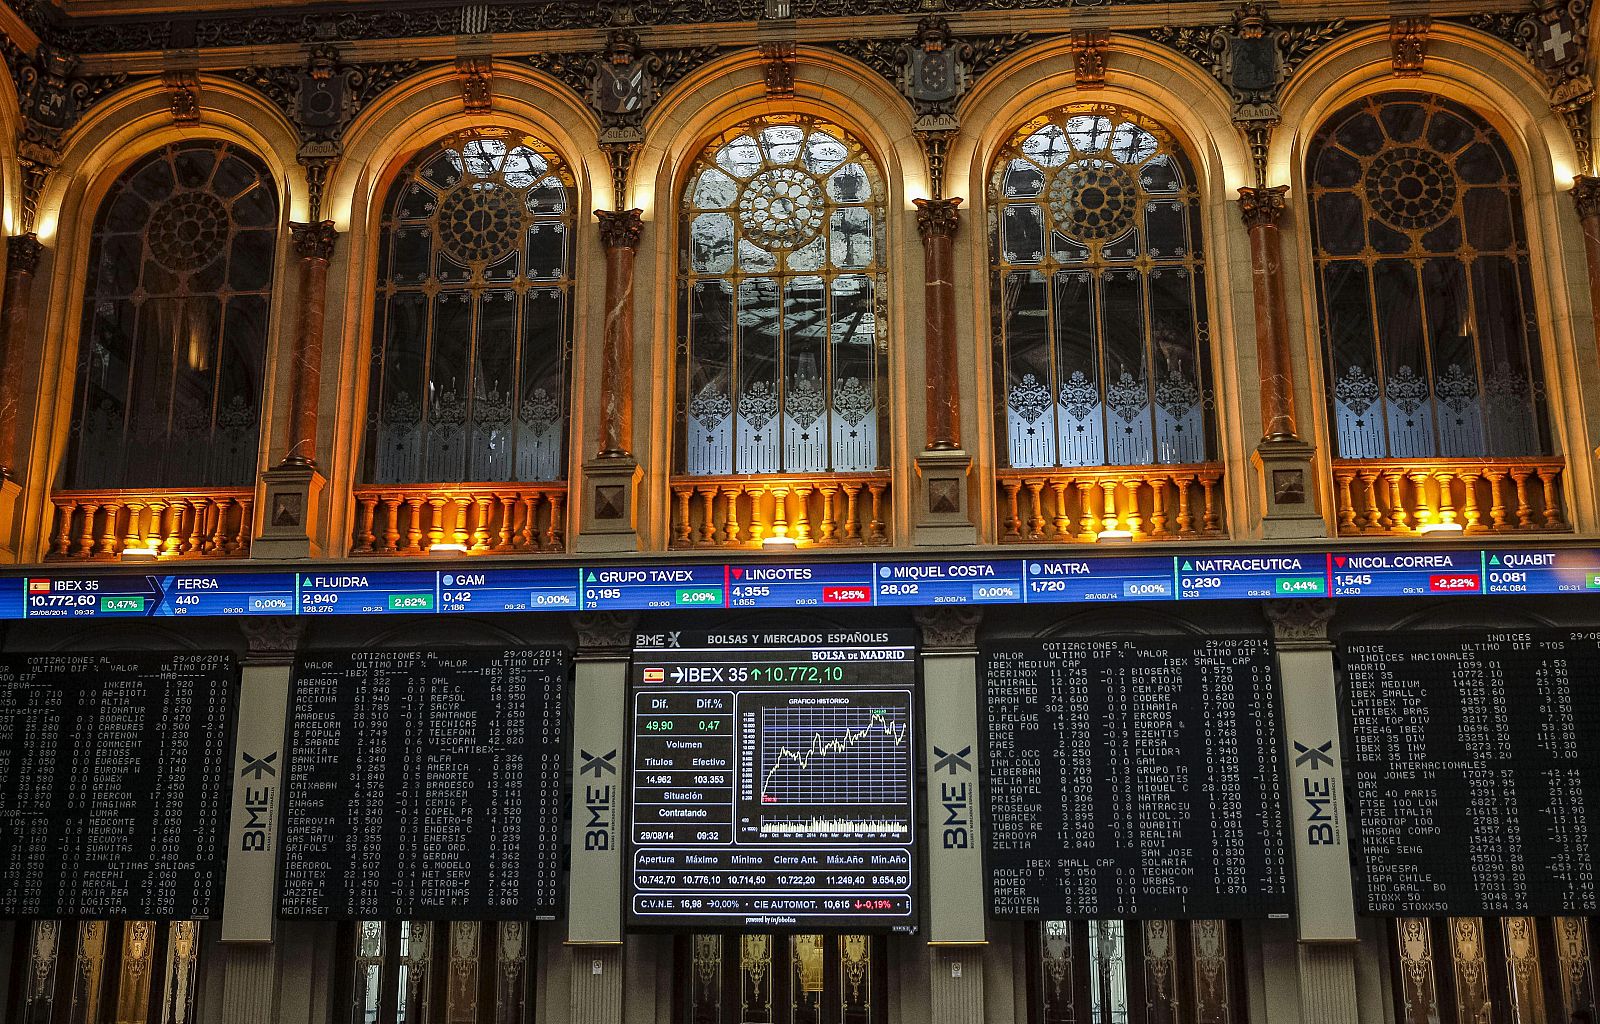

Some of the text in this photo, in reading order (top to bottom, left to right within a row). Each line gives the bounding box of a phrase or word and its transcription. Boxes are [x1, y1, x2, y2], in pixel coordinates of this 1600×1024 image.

[607, 129, 637, 139] SUECIA
[1195, 558, 1302, 571] NATRACEUTICA
[1348, 556, 1453, 569] NICOL.CORREA
[1503, 554, 1556, 567] QUABIT
[745, 569, 812, 580] LINGOTES
[894, 565, 995, 580] MIQUEL COSTA
[1044, 563, 1090, 575] NATRA
[315, 577, 369, 588] FLUIDRA
[455, 575, 485, 586] GAM
[599, 571, 694, 583] GRUPO TAVEX
[1334, 575, 1475, 589] 1,545 -2,22%
[1489, 572, 1527, 584] 0,081
[54, 580, 99, 591] IBEX 35
[177, 579, 219, 590] FERSA
[1031, 581, 1165, 594] 1,720 0,00%
[1182, 578, 1318, 591] 0,230 0,44%
[1490, 584, 1527, 592] 644.084
[586, 589, 716, 602] 0,195 2,09%
[732, 586, 865, 600] 4,355 -1,25%
[880, 584, 1013, 597] 28,02 0,00%
[1182, 590, 1200, 598] 533
[1335, 587, 1361, 595] 2.450
[30, 595, 138, 610] 10.772,60 0,47%
[175, 595, 286, 609] 440 0,00%
[302, 594, 427, 607] 2,940 2,62%
[443, 592, 570, 604] 0,42 0,00%
[707, 631, 889, 644] BOLSAS Y MERCADOS ESPAÑOLES
[1042, 640, 1269, 651] COTIZACIONES AL 29/08/2014
[27, 657, 95, 665] COTIZACIONES
[173, 655, 229, 663] 29/08/2014
[351, 652, 421, 660] COTIZACIONES
[503, 650, 562, 658] 29/08/2014
[811, 651, 846, 661] BOLSA
[860, 650, 905, 660] MADRID
[1410, 652, 1475, 661] NACIONALES
[356, 661, 392, 669] ULTIMO
[684, 666, 843, 684] IBEX 35 10.772,10
[987, 669, 1088, 678] ACERINOX 11.745
[1349, 671, 1393, 680] IBEX 35
[987, 678, 1088, 687] ALMIRALL 12.020
[297, 687, 338, 695] ABERTIS
[430, 694, 466, 702] REPSOL
[1132, 693, 1235, 702] CODERE 0.620
[652, 698, 723, 709] Dif. Dif.%
[353, 712, 389, 720] 28.510
[646, 721, 720, 731] 49,90 0,47
[666, 740, 703, 749] Volumen
[692, 758, 726, 766] Efectivo
[693, 776, 724, 784] 103.353
[663, 791, 703, 800] Situación
[1358, 790, 1378, 798] CAC
[1404, 789, 1437, 797] PARIS
[659, 809, 707, 818] Contratando
[640, 831, 719, 840] 29/08/14 09:32
[1362, 837, 1401, 845] NIKKEI
[639, 855, 675, 865] Apertura
[685, 855, 719, 864] Máximo
[773, 855, 799, 864] Cierre
[800, 855, 819, 864] Ant.
[827, 854, 864, 864] Máx.Año
[638, 876, 907, 885] 10.742,70 10.776,10 10.714,50 10.722,20 11.249,40 9.654,80
[641, 900, 675, 908] C.V.N.E.
[714, 900, 740, 909] 0,00%
[754, 900, 769, 909] CIE
[771, 900, 818, 909] AUTOMOT.
[823, 900, 850, 909] 10,615
[863, 900, 891, 909] -0,19%
